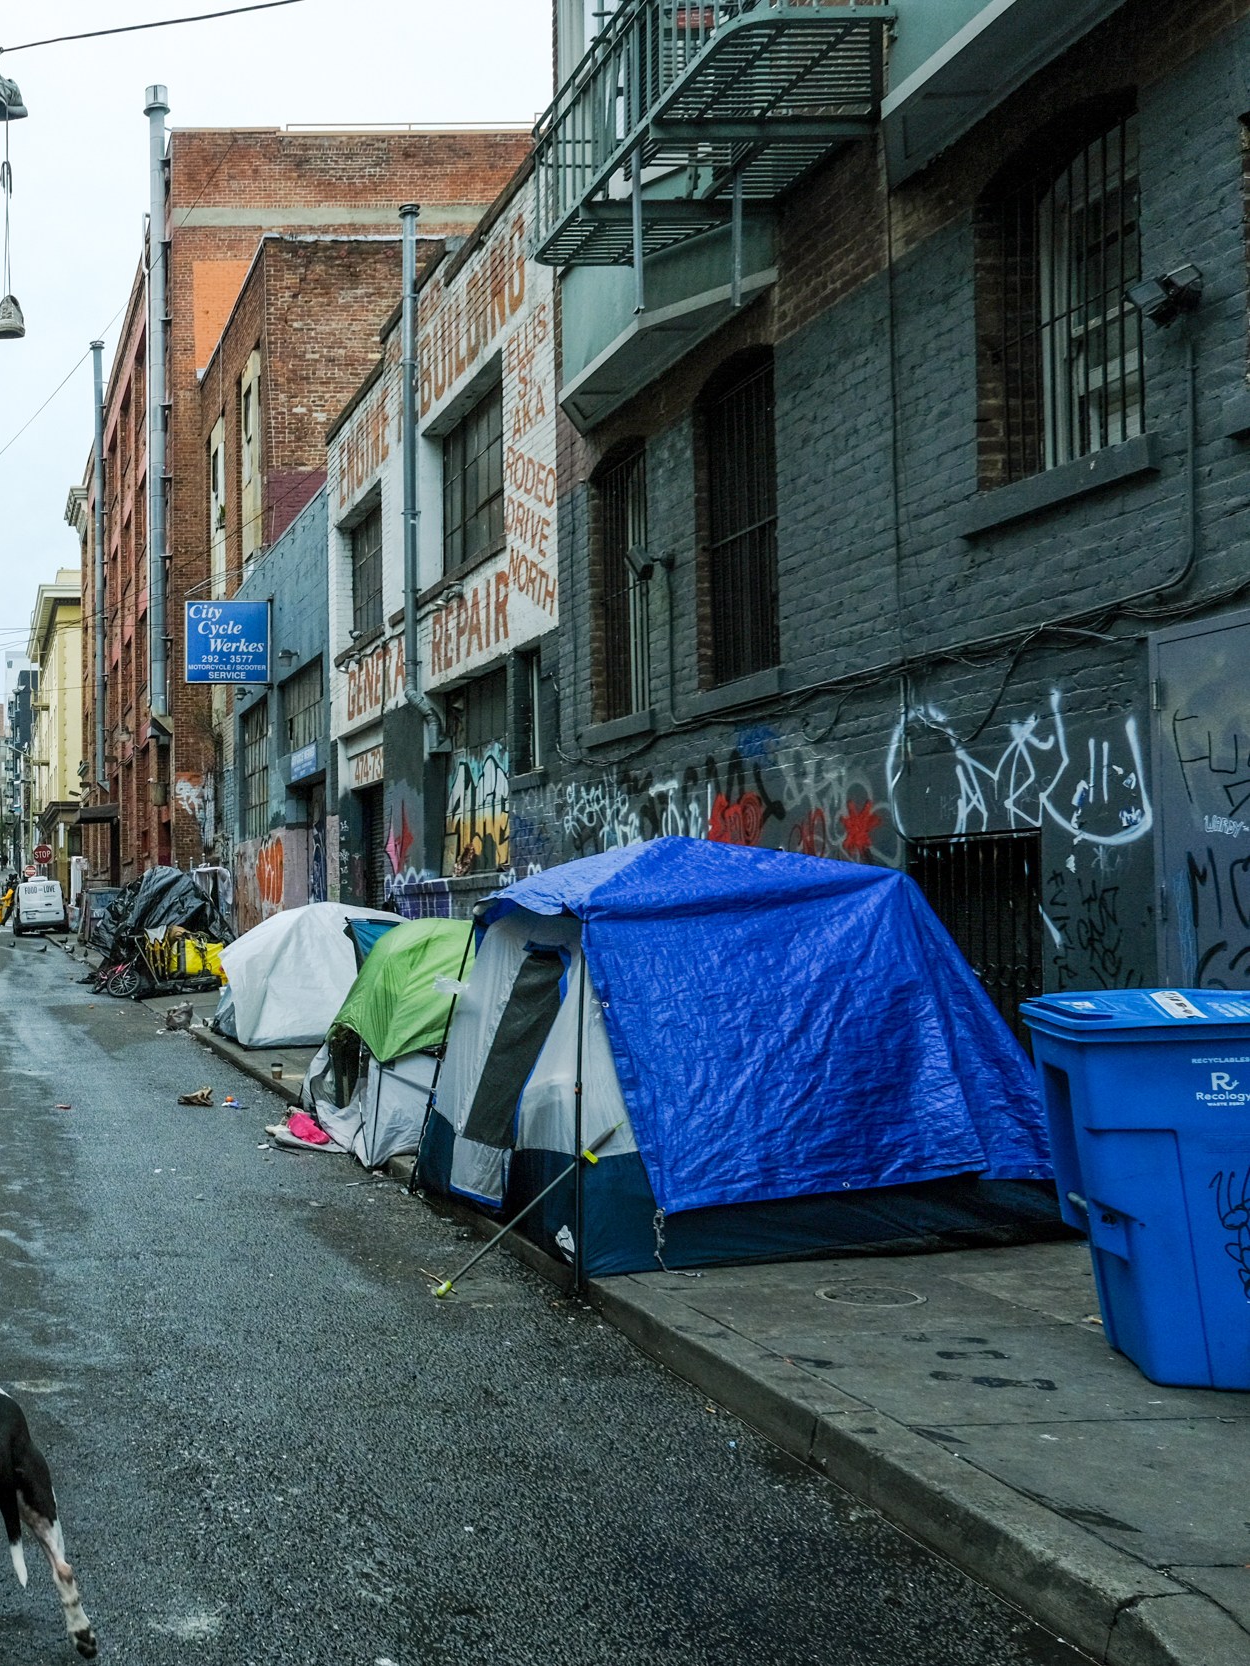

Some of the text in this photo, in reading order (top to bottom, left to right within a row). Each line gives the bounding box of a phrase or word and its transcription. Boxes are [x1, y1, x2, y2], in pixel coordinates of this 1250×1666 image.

[397, 213, 525, 443] BUILDING
[507, 303, 547, 376] ELLIS
[505, 446, 558, 508] RODEO
[505, 495, 551, 558] DRIVE
[508, 546, 556, 617] NORTH
[189, 604, 223, 621] City
[197, 620, 243, 638] Cycle
[209, 638, 265, 653] Werkes
[347, 571, 510, 722] GENERA REPAIR
[201, 655, 219, 663] 292
[229, 655, 253, 663] 3577
[208, 671, 247, 679] SERVICE
[354, 747, 383, 785] 474-73
[34, 851, 51, 859] STOP
[24, 886, 38, 895] FOOD
[43, 884, 56, 894] LOVE
[1195, 1091, 1250, 1102] Recology
